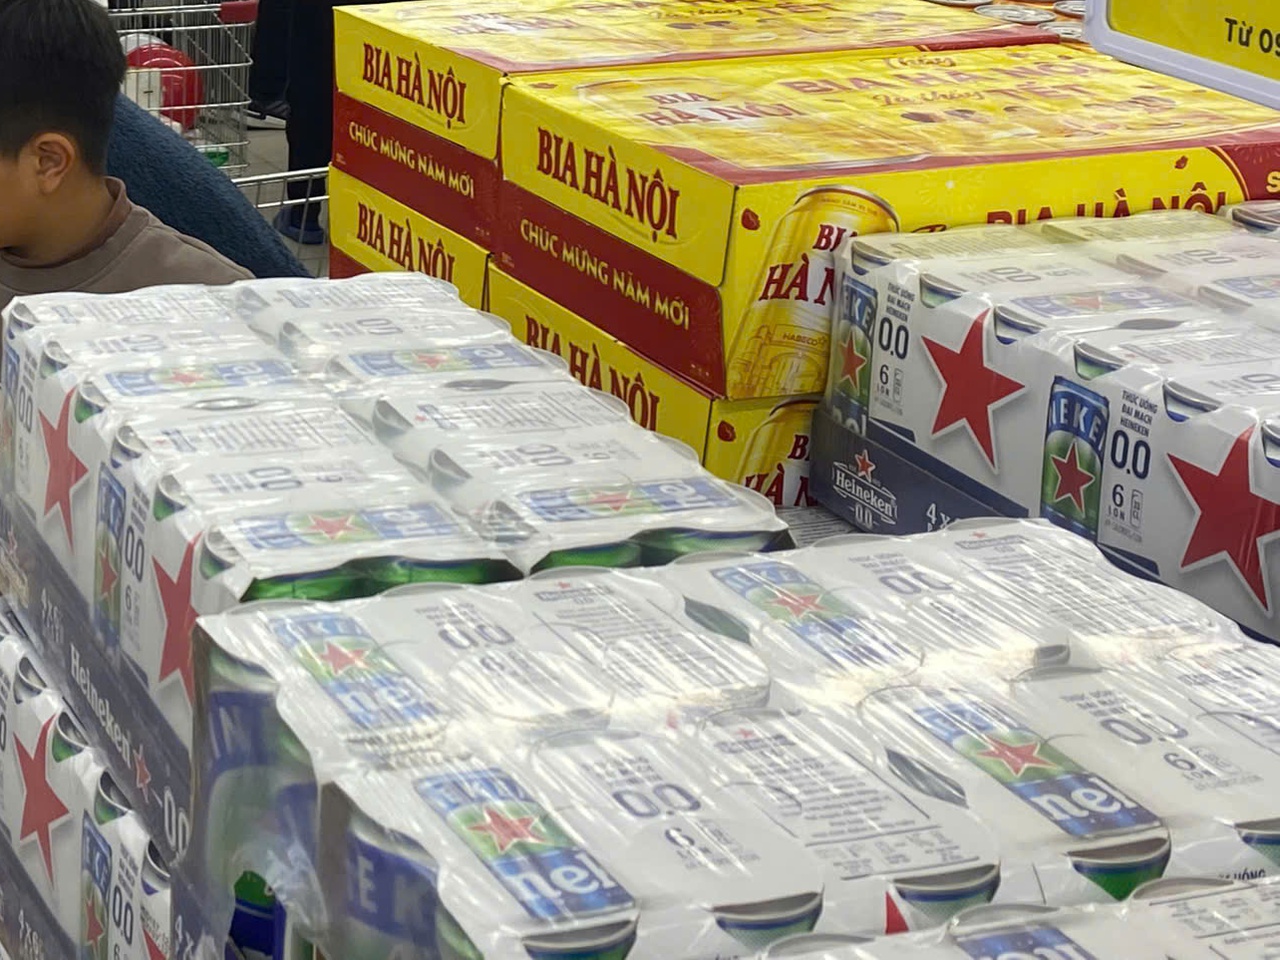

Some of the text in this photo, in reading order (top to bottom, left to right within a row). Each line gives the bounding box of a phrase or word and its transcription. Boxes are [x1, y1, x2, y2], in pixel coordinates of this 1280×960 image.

[1224, 17, 1253, 49] Từ
[361, 41, 467, 130] BIA HÀ NỘI
[348, 120, 475, 200] CHÚC MỪNG NĂM MỚI
[536, 126, 681, 243] BIA HÀ NỘI
[357, 201, 386, 250] BIA
[388, 218, 413, 269] HÀ
[520, 218, 690, 331] CHÚC MỪNG NĂM MỚI
[758, 252, 810, 303] HÀ
[878, 316, 910, 360] 0.0
[568, 342, 602, 389] HÀ
[880, 364, 890, 385] 6
[1120, 416, 1151, 438] HEINEKEN
[1110, 429, 1152, 481] 0.0
[835, 469, 894, 518] Heineken
[926, 502, 938, 525] 4
[1111, 483, 1125, 508] 6
[124, 524, 146, 583] 0.0
[70, 641, 133, 770] Heineken
[1163, 752, 1197, 771] 6
[111, 885, 134, 947] 0.0
